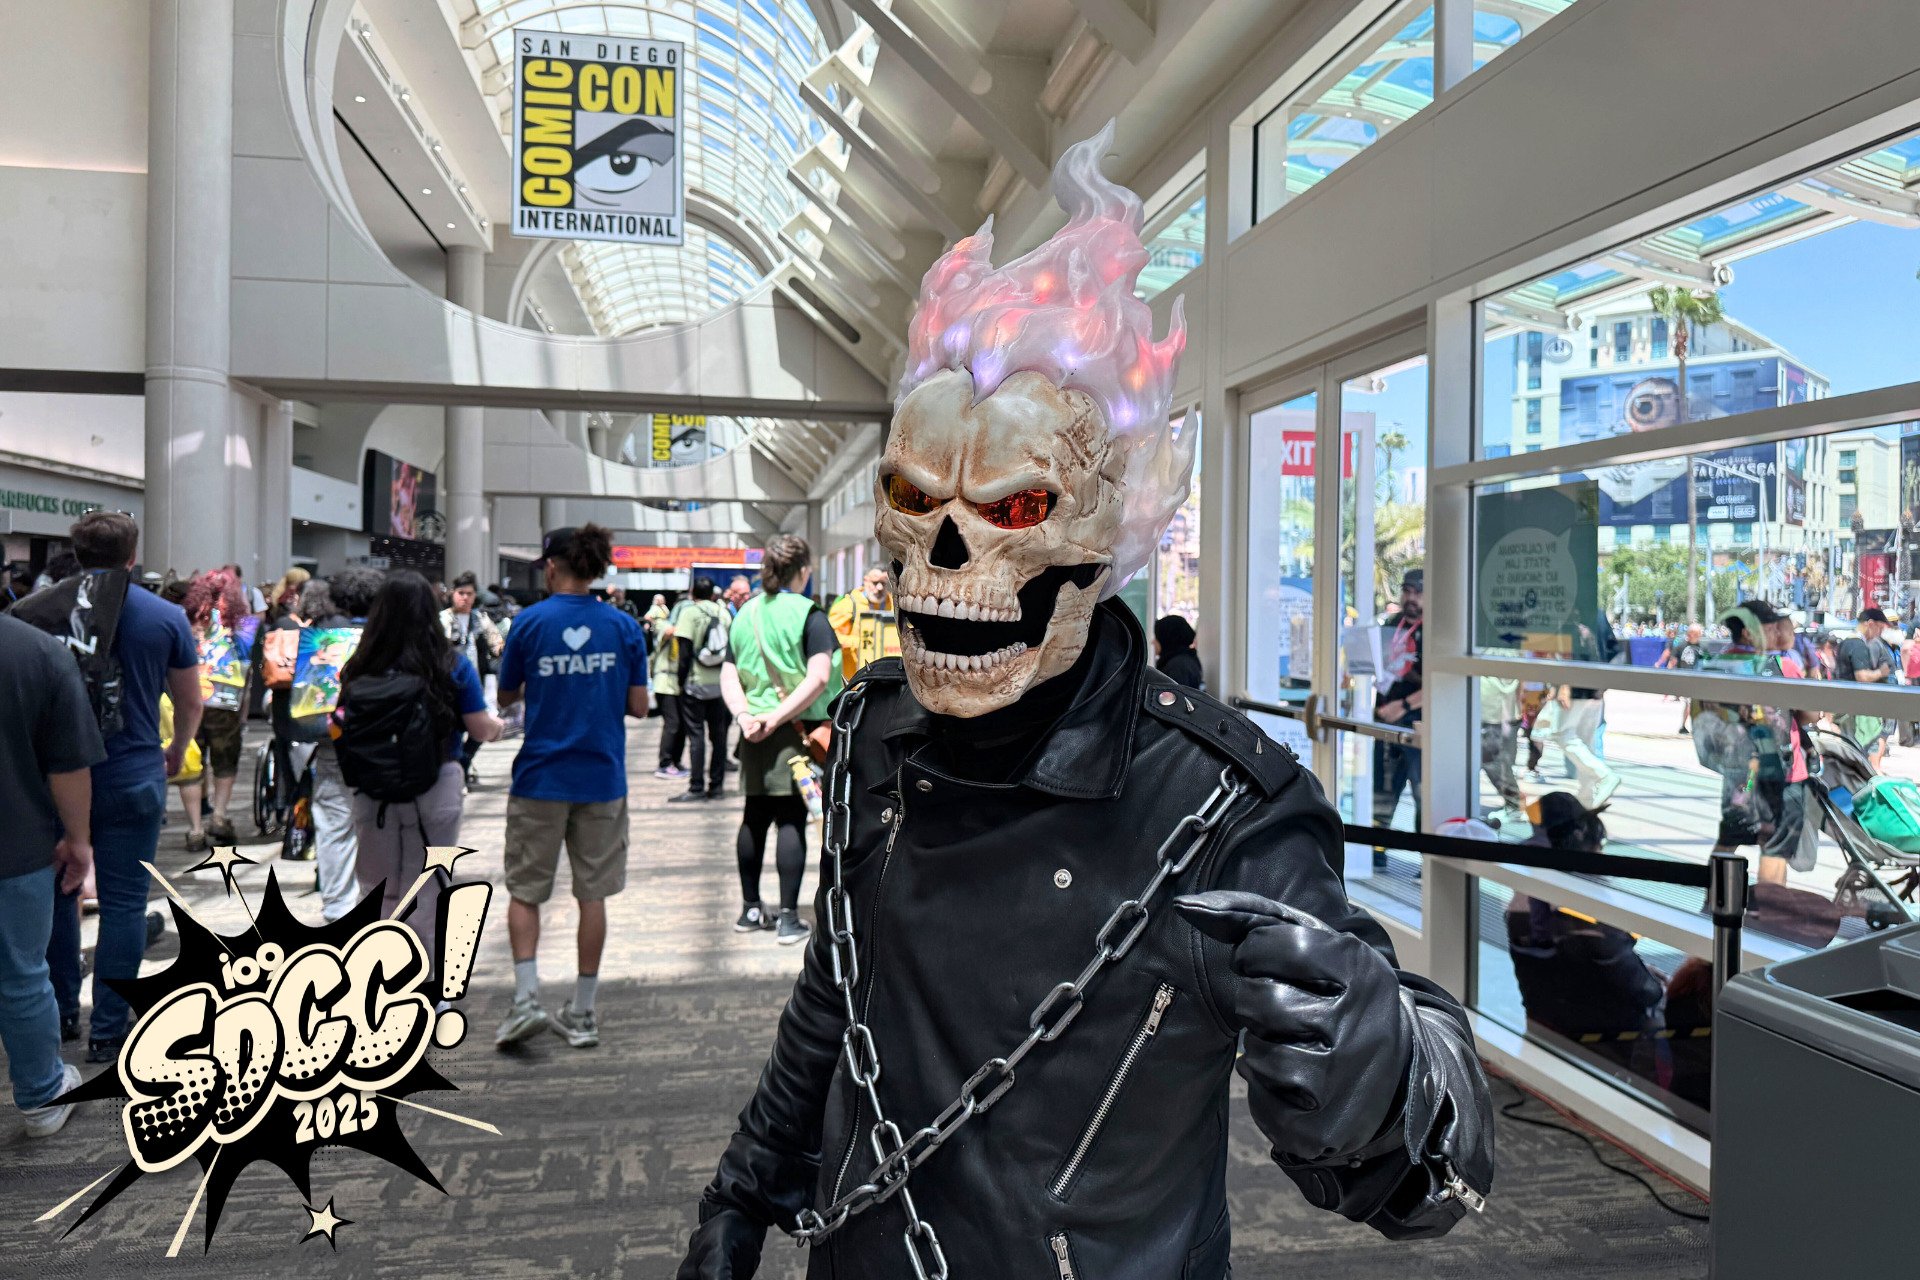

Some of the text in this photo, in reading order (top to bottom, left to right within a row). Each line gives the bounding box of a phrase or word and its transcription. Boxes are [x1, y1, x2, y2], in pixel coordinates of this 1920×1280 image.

[522, 37, 677, 65] SAN DIEGO
[578, 63, 675, 118] CON
[522, 59, 574, 207] COMIC
[520, 209, 678, 238] INTERNATIONAL
[1281, 440, 1316, 466] XIT
[538, 652, 617, 677] STAFF
